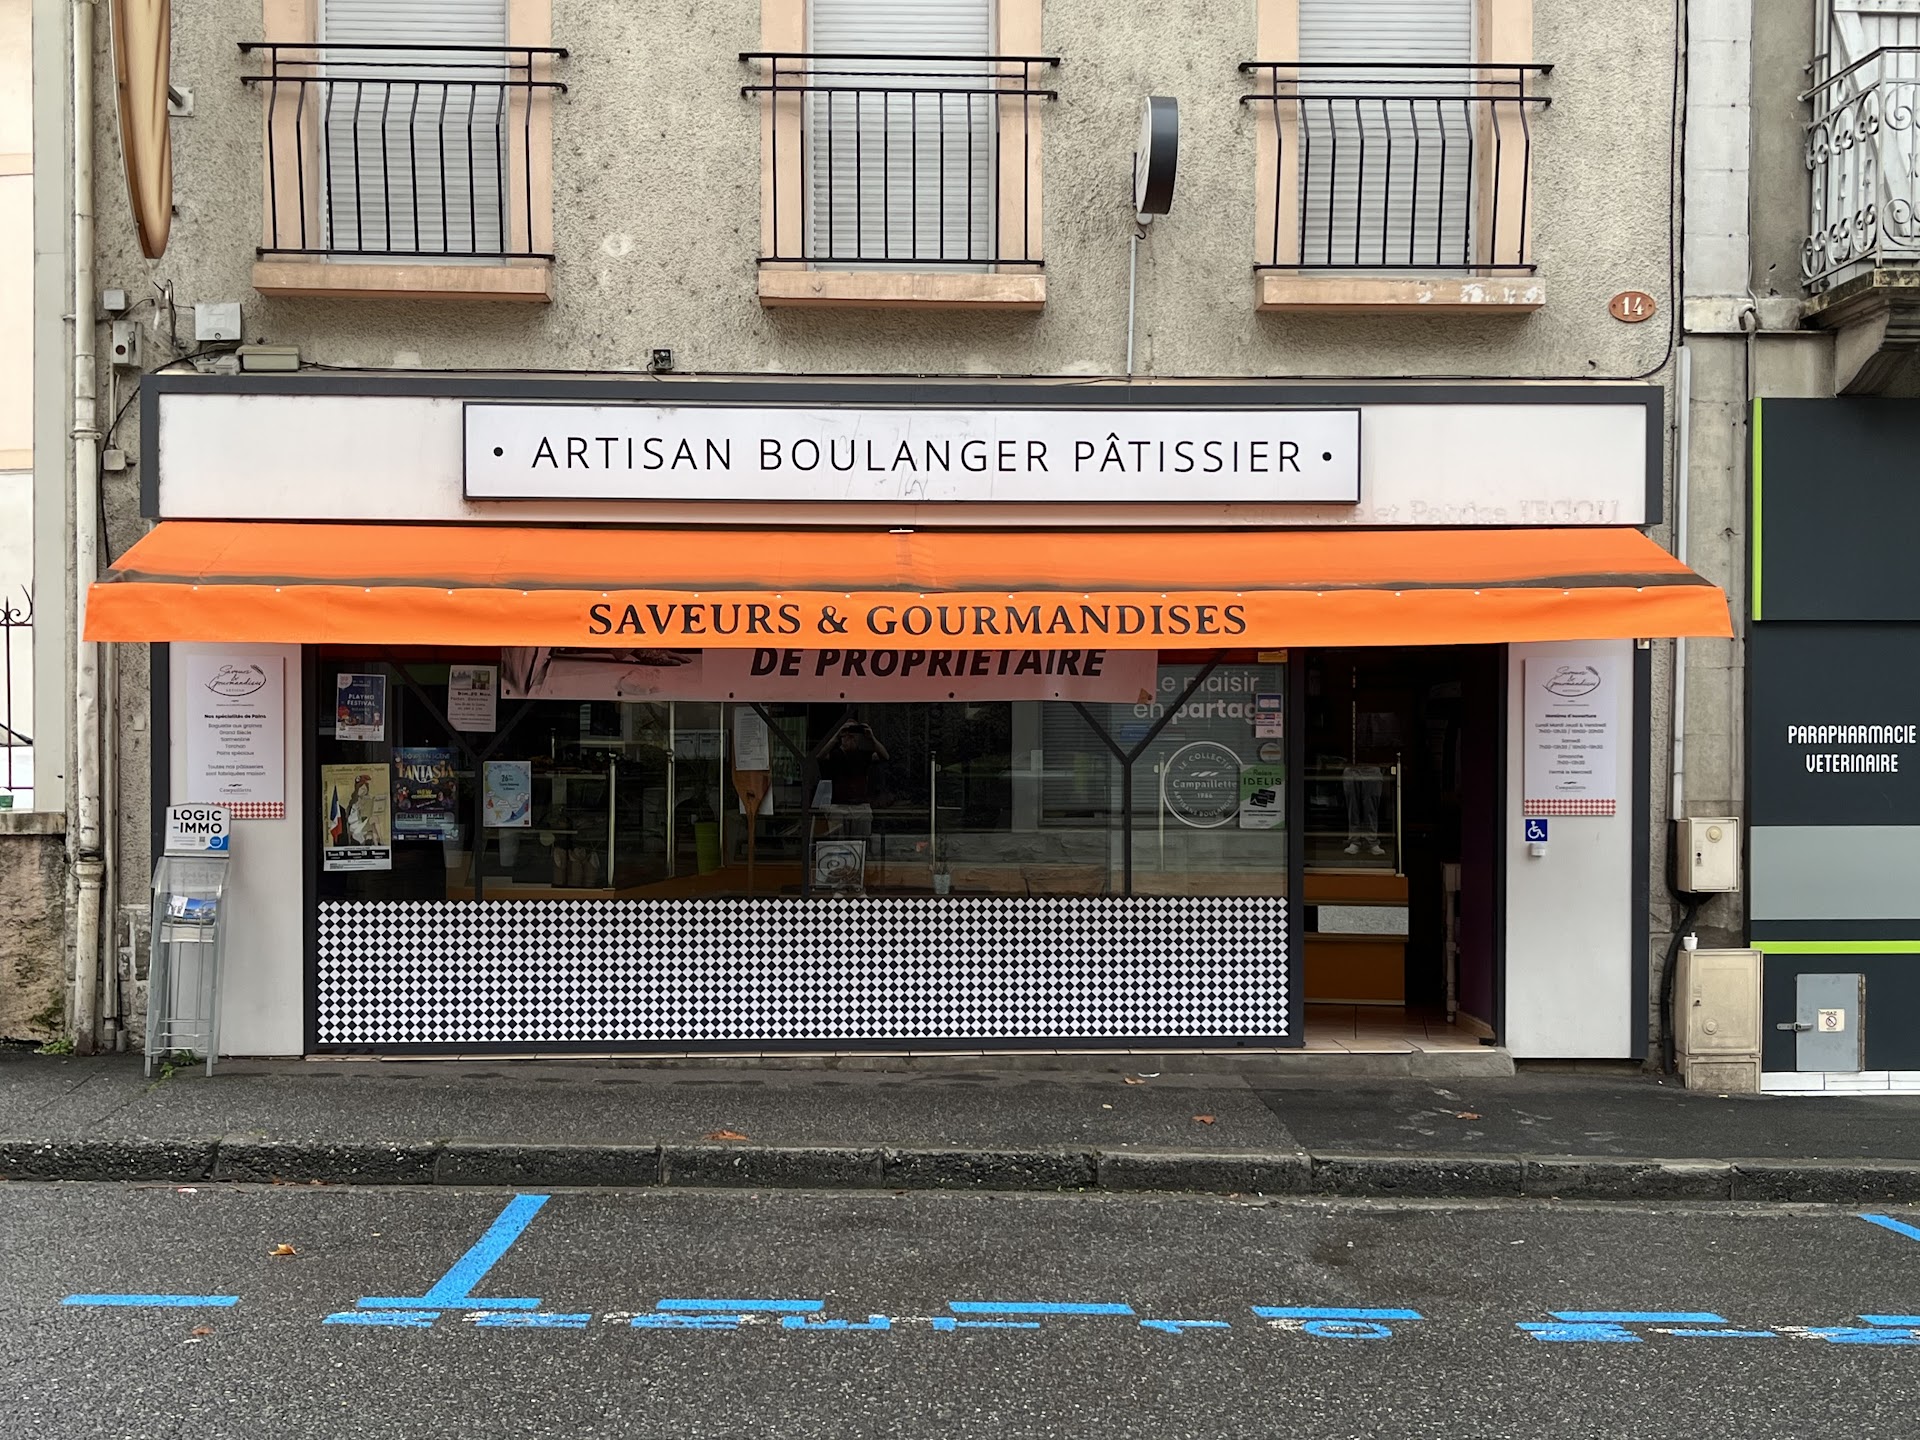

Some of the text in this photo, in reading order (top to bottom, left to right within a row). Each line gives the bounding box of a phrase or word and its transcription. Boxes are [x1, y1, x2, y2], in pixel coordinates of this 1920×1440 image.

[1621, 296, 1644, 316] 14
[531, 432, 1301, 473] ARTISAN BOULANGER PÂTISSIER
[589, 603, 1247, 636] SAVEURS & GOURMANDISES
[750, 648, 803, 677] DE
[1156, 676, 1176, 692] e
[1133, 699, 1257, 725] en partag
[1788, 725, 1917, 744] PARAPHARMACIE
[1188, 752, 1233, 771] COLLECTIF
[1806, 754, 1899, 773] VETERINAIRE
[397, 761, 455, 785] FANTASIA
[1243, 777, 1282, 785] IDELIS
[1172, 779, 1238, 790] Campaillette
[1173, 791, 1198, 816] ARTISANS
[173, 809, 222, 821] LOGIC
[173, 822, 222, 834] -IMMO
